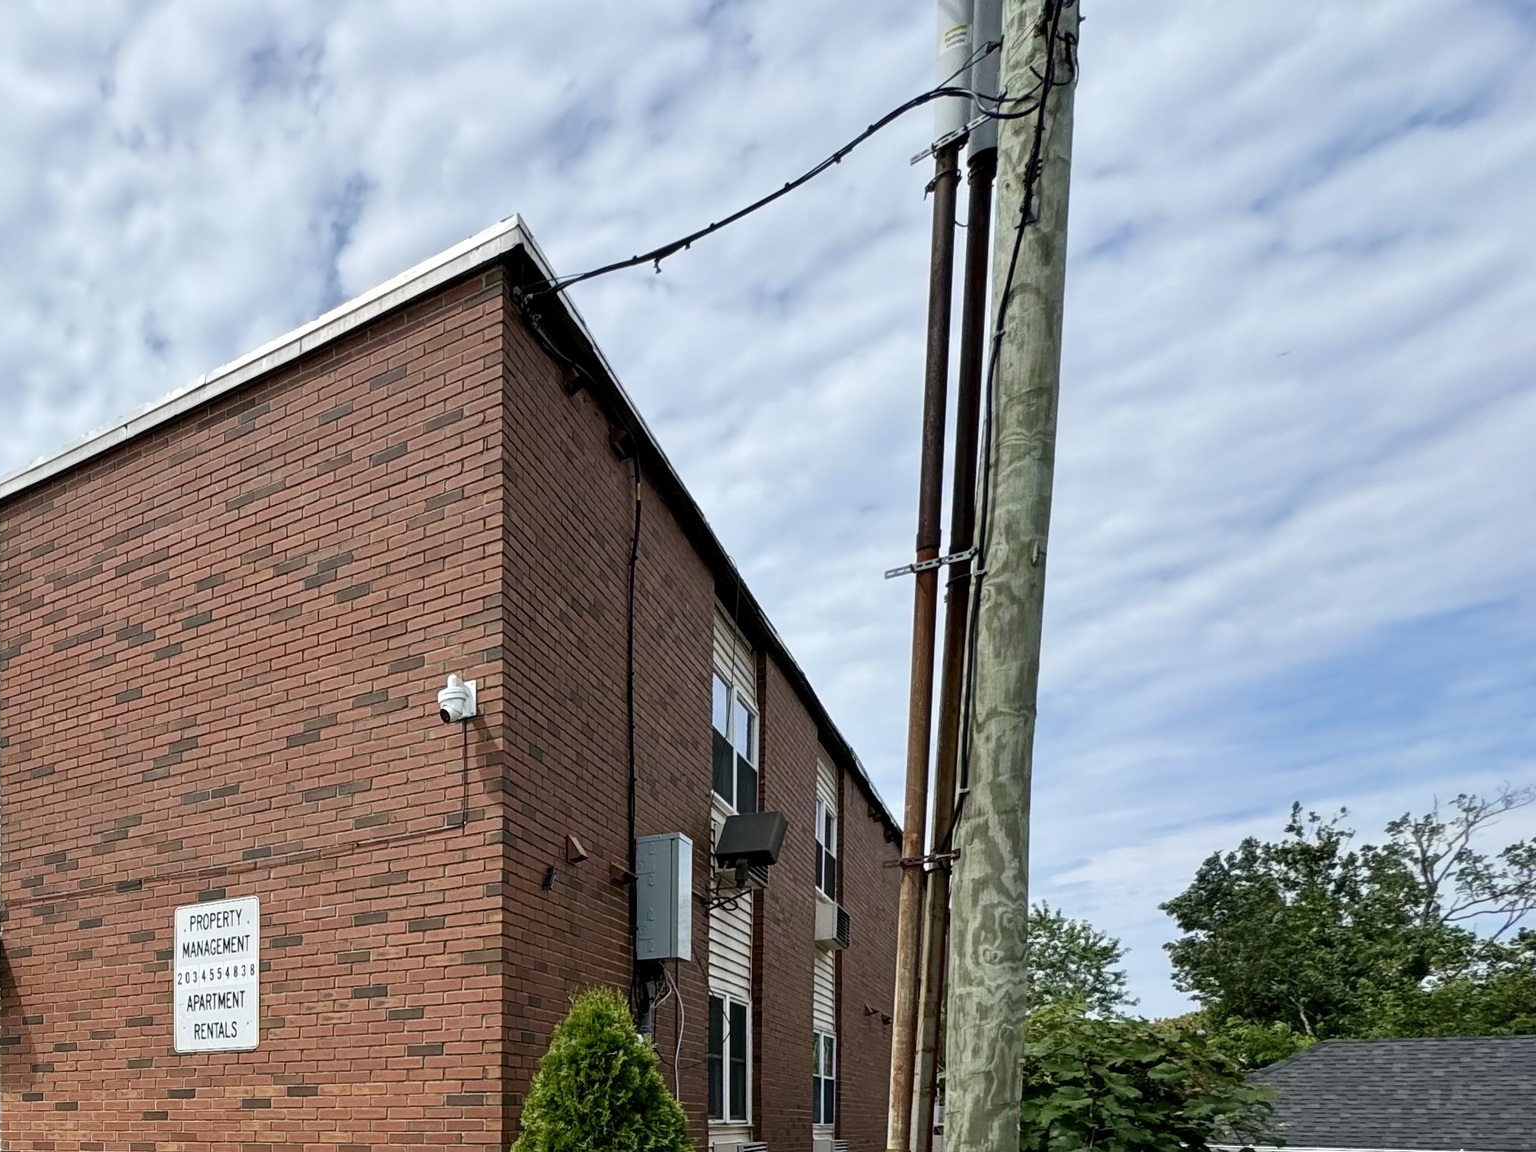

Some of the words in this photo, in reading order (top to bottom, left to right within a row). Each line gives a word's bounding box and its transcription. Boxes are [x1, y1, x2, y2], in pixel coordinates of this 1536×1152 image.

[190, 909, 243, 932] PROPERTY
[182, 934, 251, 959] MANAGEMENT
[186, 990, 245, 1012] APARTMENT
[194, 1021, 237, 1041] RENTALS
